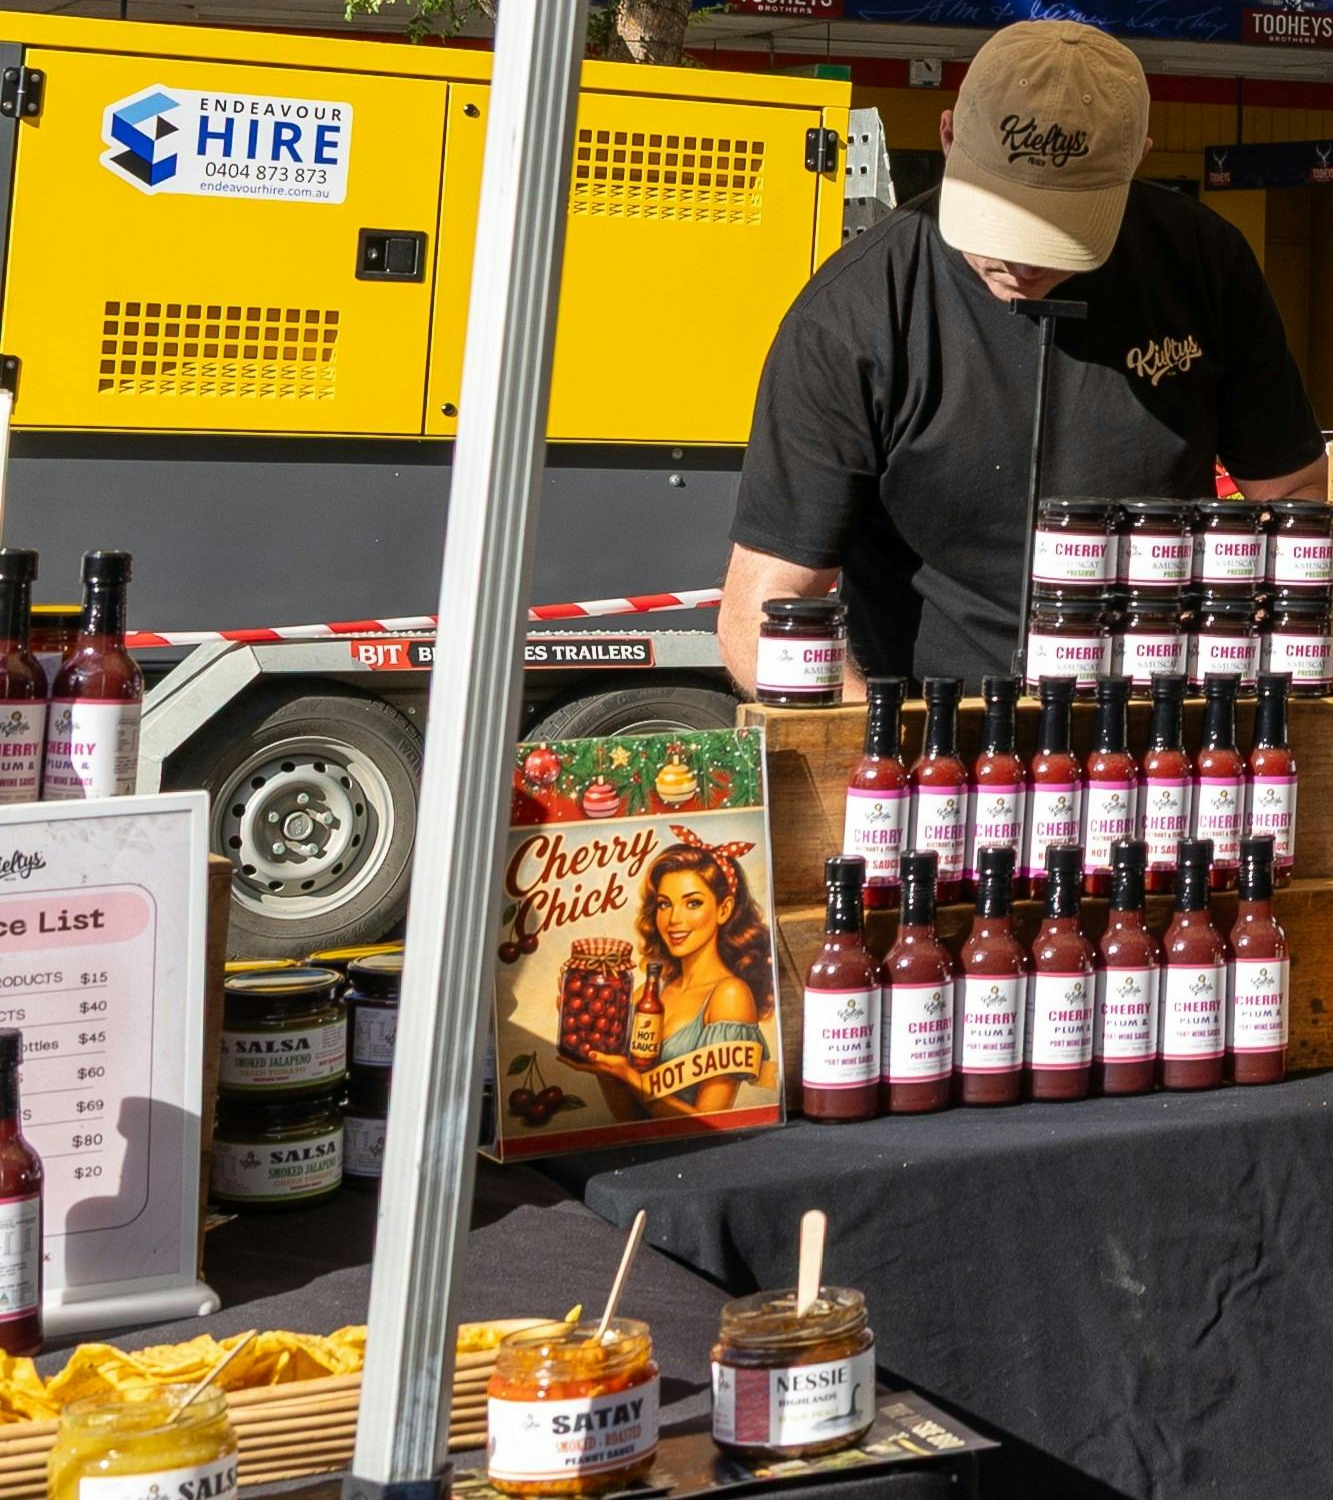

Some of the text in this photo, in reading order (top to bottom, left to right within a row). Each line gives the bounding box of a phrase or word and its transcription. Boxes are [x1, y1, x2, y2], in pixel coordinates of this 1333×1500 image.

[757, 5, 812, 15] BROTHERS
[1252, 13, 1333, 37] TOOHEYS
[1268, 35, 1316, 44] BROTHERS
[199, 97, 342, 121] ENDEAVOUR
[196, 115, 341, 166] HIRE
[1000, 114, 1089, 168] Kieltys
[205, 161, 327, 185] 0404 873 873
[199, 180, 330, 199] endeavourhire.com.au
[1127, 335, 1203, 387] Kieltys
[359, 645, 400, 667] BJT
[551, 644, 646, 661] TRAILERS
[505, 825, 660, 898] Cherry
[515, 873, 628, 941] Chick
[39, 908, 105, 934] List
[80, 972, 108, 985] $15
[79, 1000, 107, 1015] $40
[964, 1011, 1018, 1026] CHERRY
[78, 1031, 106, 1046] $45
[636, 1030, 656, 1042] HOT
[821, 1026, 874, 1041] CHERRY
[236, 1038, 311, 1054] SALSA
[632, 1039, 659, 1053] SAUCE
[235, 1056, 265, 1069] SMOKED
[648, 1045, 755, 1095] HOT SAUCE
[77, 1066, 105, 1080] $60
[76, 1099, 104, 1114] $69
[72, 1133, 103, 1149] $80
[270, 1141, 336, 1164] SALSA
[74, 1166, 102, 1180] $20
[777, 1368, 848, 1394] NESSIE
[778, 1392, 838, 1408] HIGHLANDS
[552, 1398, 644, 1434] SATAY
[555, 1425, 642, 1454] SMOKED ROASTED
[565, 1445, 636, 1466] PEANUT SAUCE
